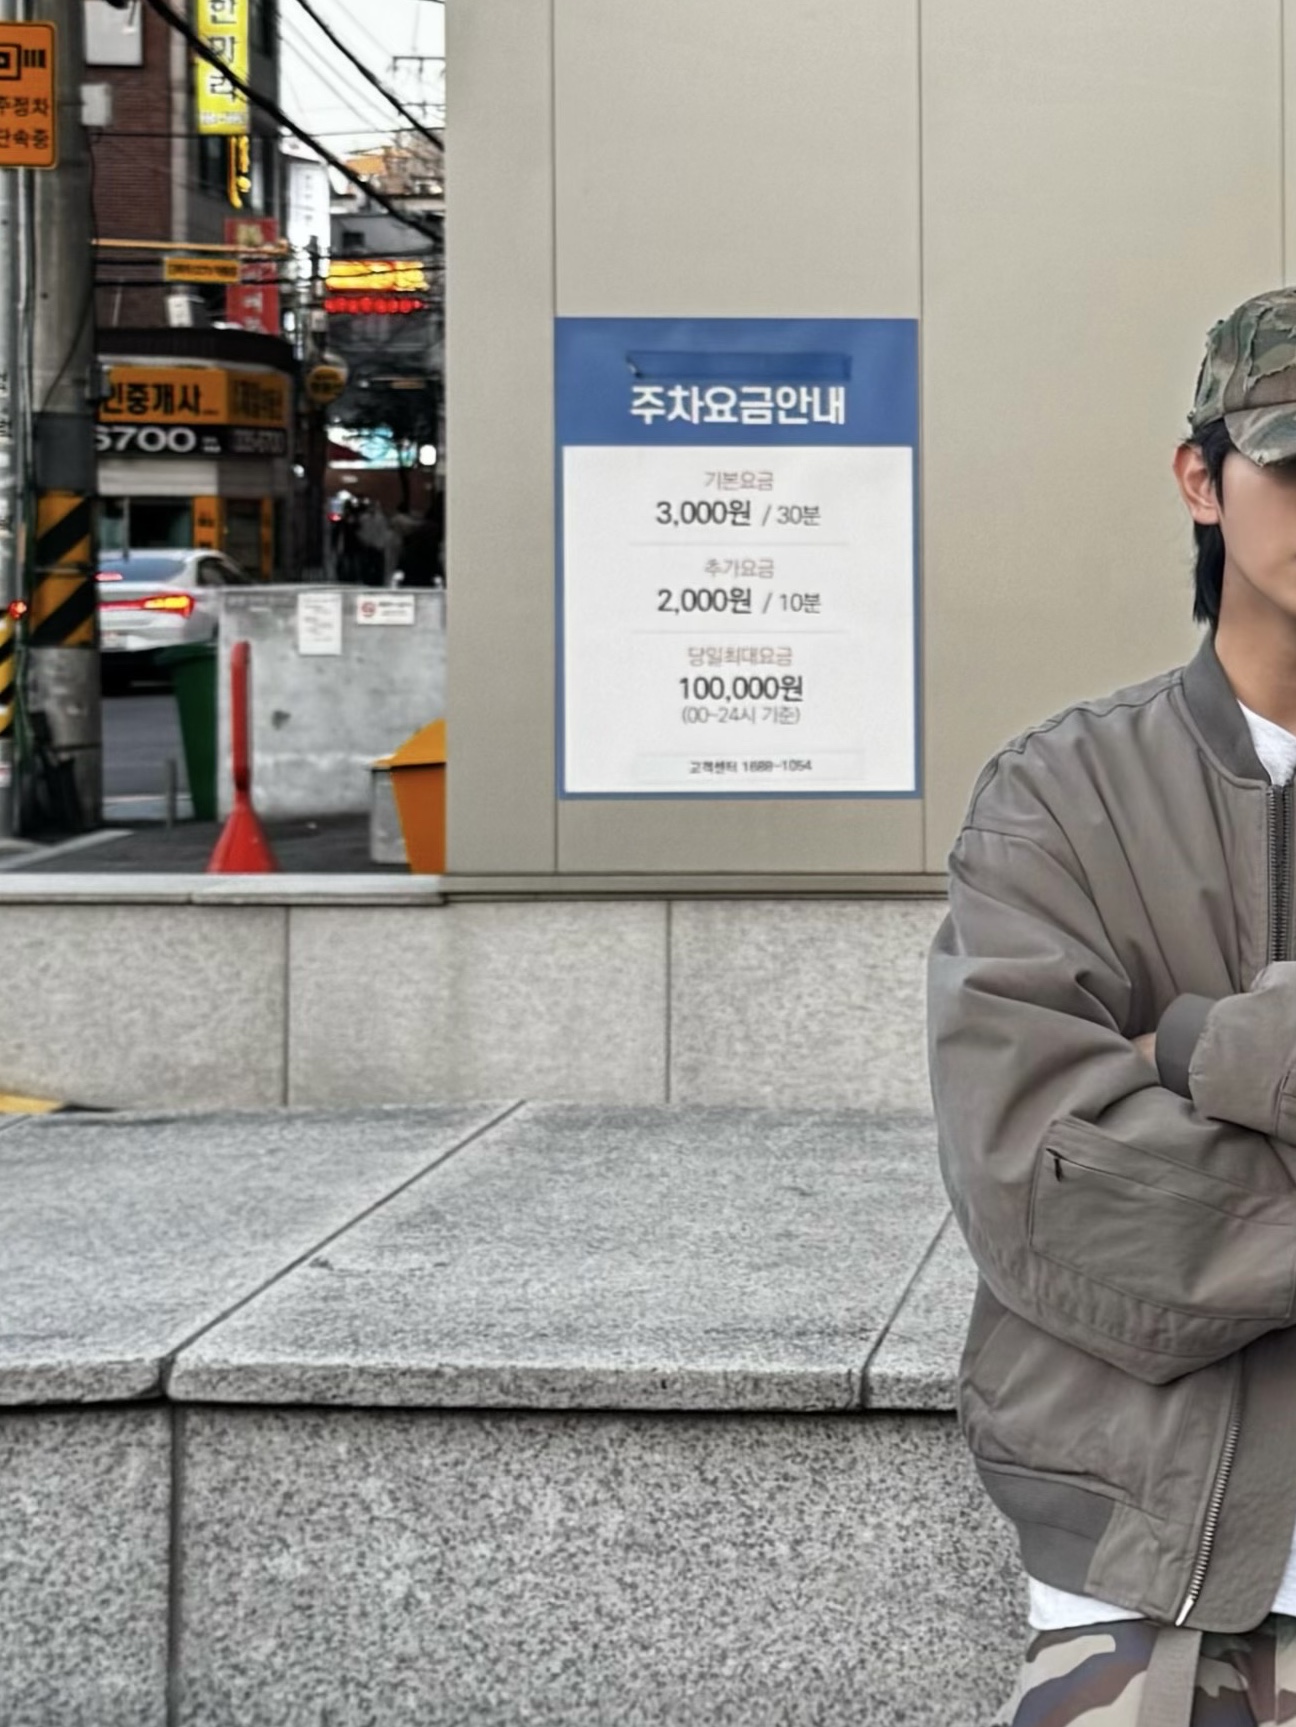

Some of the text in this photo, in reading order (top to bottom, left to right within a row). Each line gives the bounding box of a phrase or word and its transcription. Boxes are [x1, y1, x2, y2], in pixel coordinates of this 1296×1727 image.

[631, 386, 846, 424] 주차요금안내
[704, 471, 774, 491] 기본요금
[656, 500, 752, 526] 3,000원
[776, 504, 821, 526] 30분
[704, 558, 774, 579] 추가요금
[657, 588, 752, 615] 2,000원
[780, 593, 821, 614] 10분
[688, 647, 793, 667] 당일최대요금
[679, 675, 804, 702] 100,000원
[761, 705, 801, 725] 기준)
[690, 760, 737, 774] 고객센터
